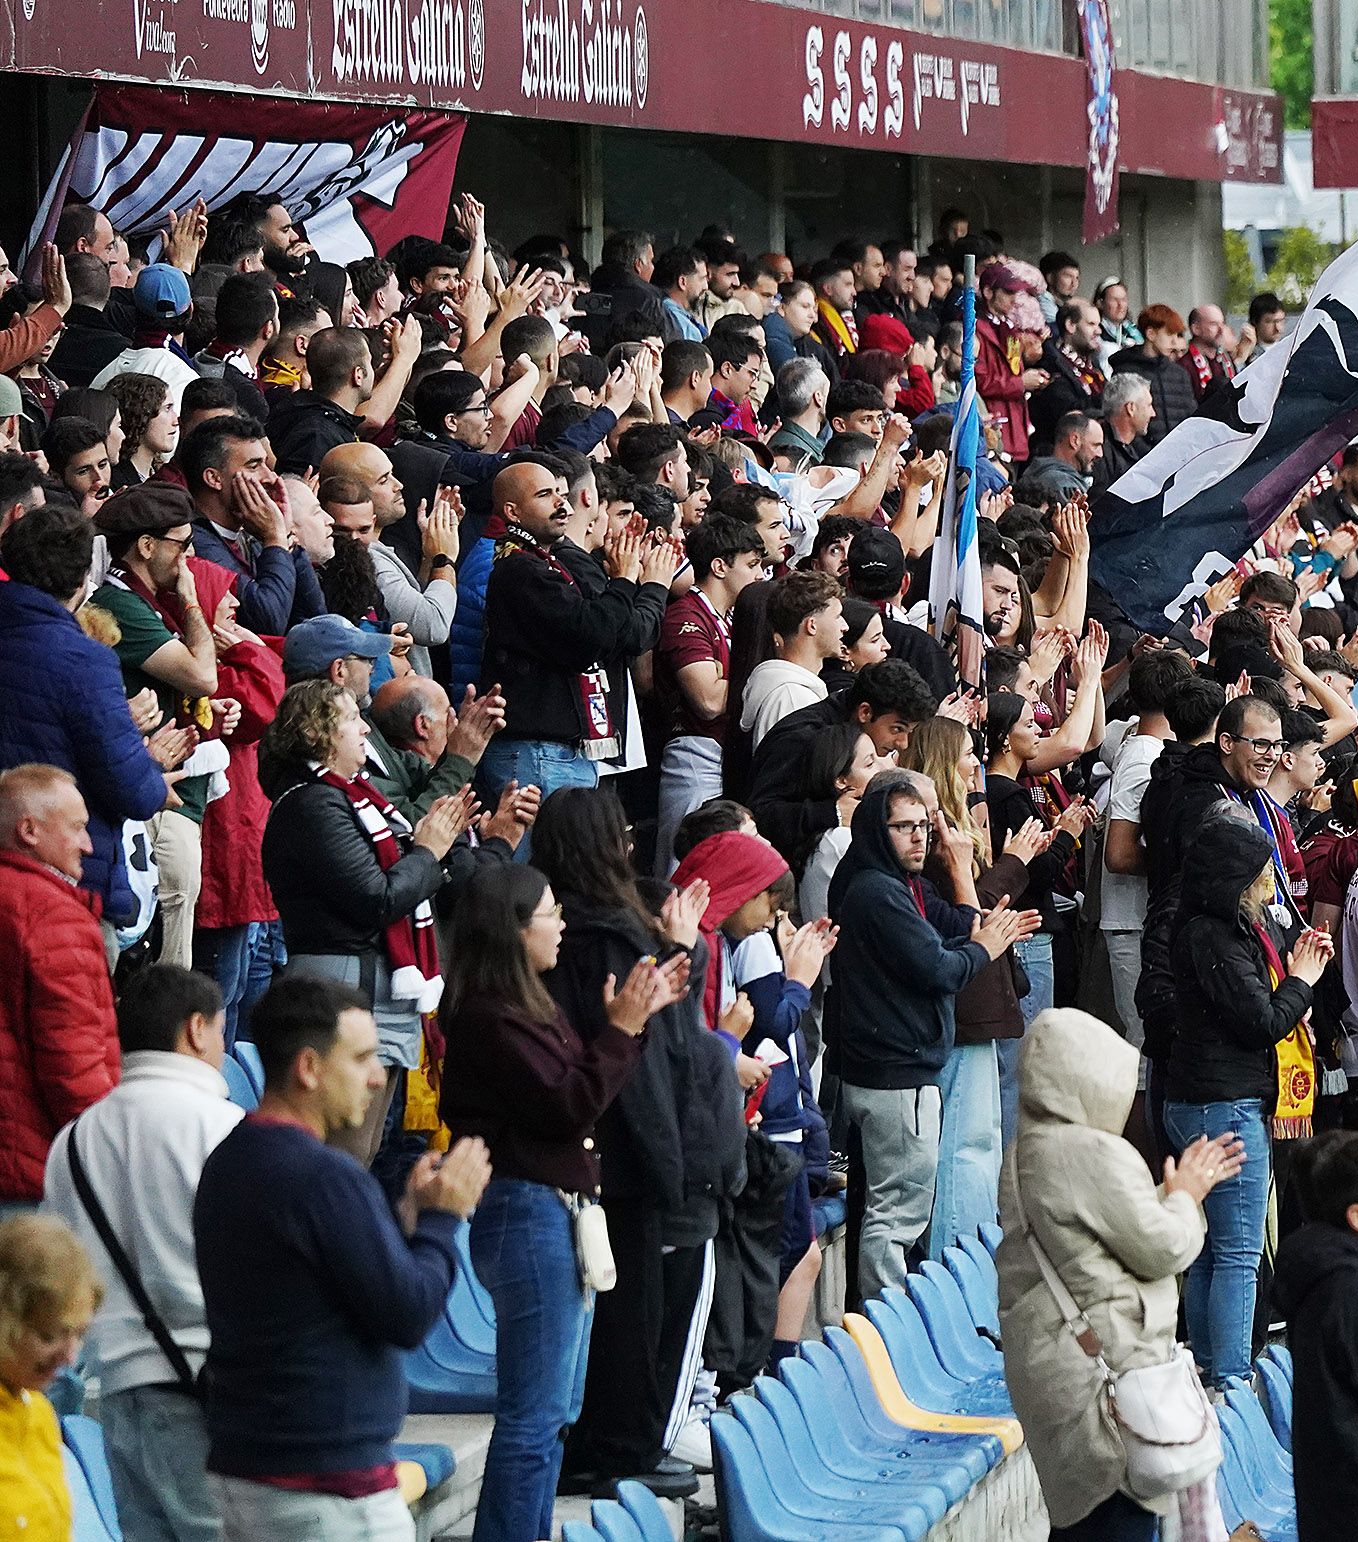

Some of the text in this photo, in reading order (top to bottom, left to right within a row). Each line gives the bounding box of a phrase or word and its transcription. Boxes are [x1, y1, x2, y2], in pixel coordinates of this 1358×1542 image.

[332, 0, 466, 89] Estrella Galicia
[521, 0, 633, 108] Estrella Galicia
